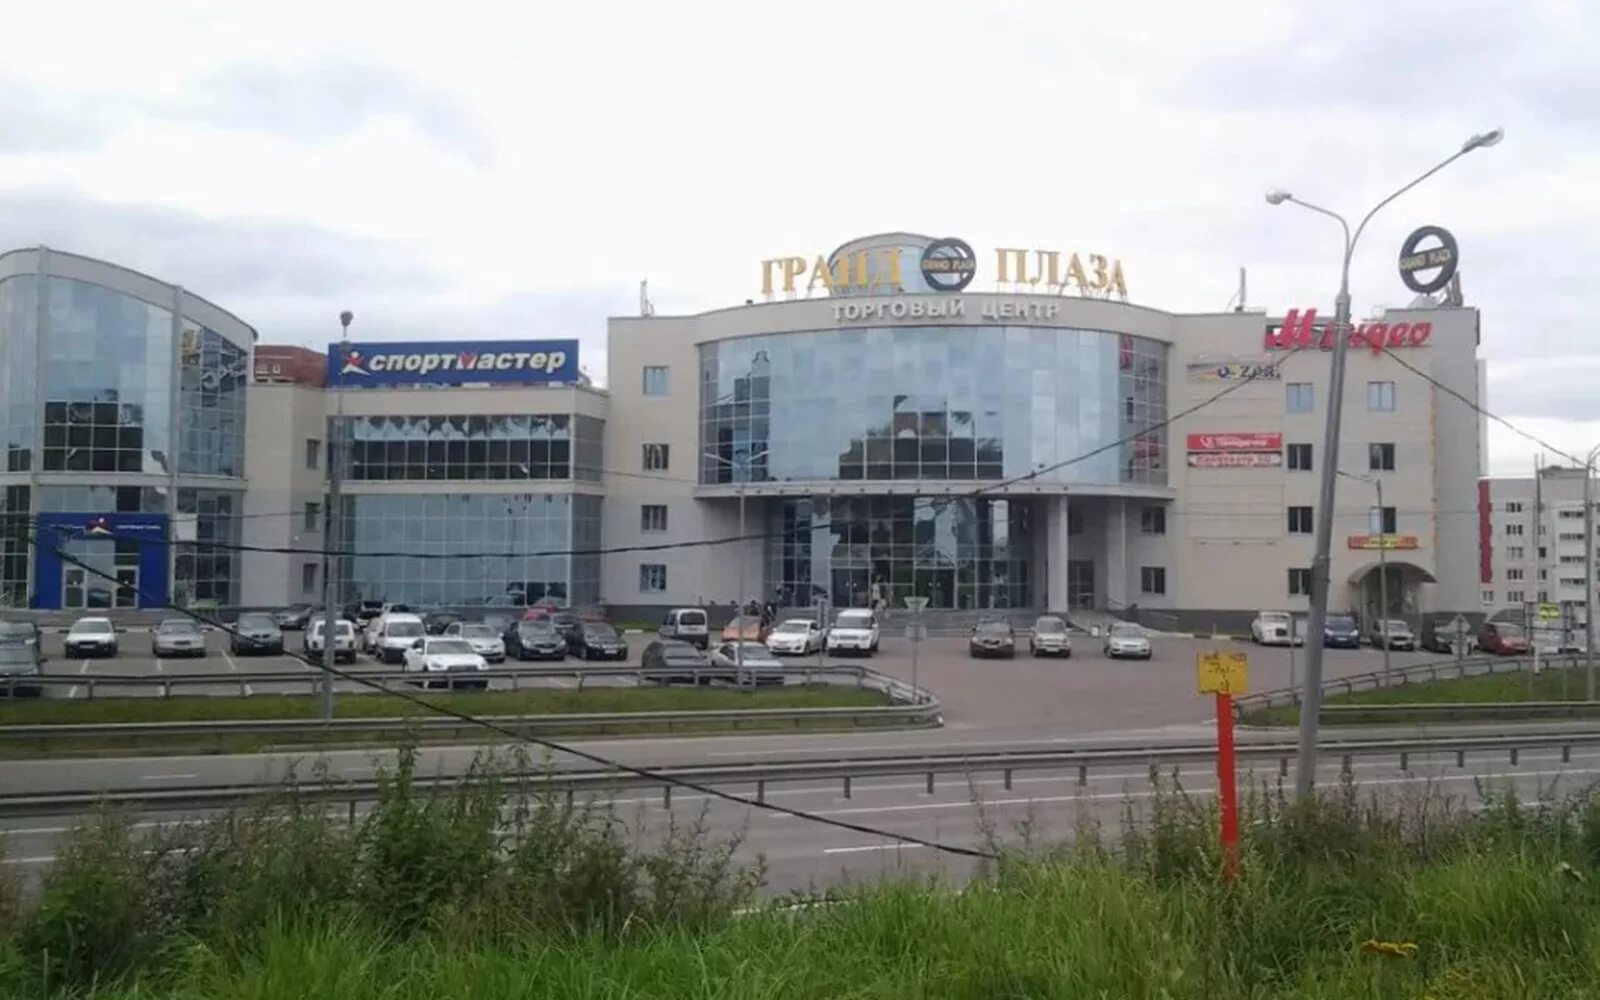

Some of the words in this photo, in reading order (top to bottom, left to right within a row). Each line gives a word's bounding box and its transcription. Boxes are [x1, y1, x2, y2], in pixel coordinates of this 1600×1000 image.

[995, 247, 1128, 294] ПЛАЗА
[832, 298, 966, 322] ТОРГОВЫЙ
[981, 298, 1061, 321] ЦЕНТР
